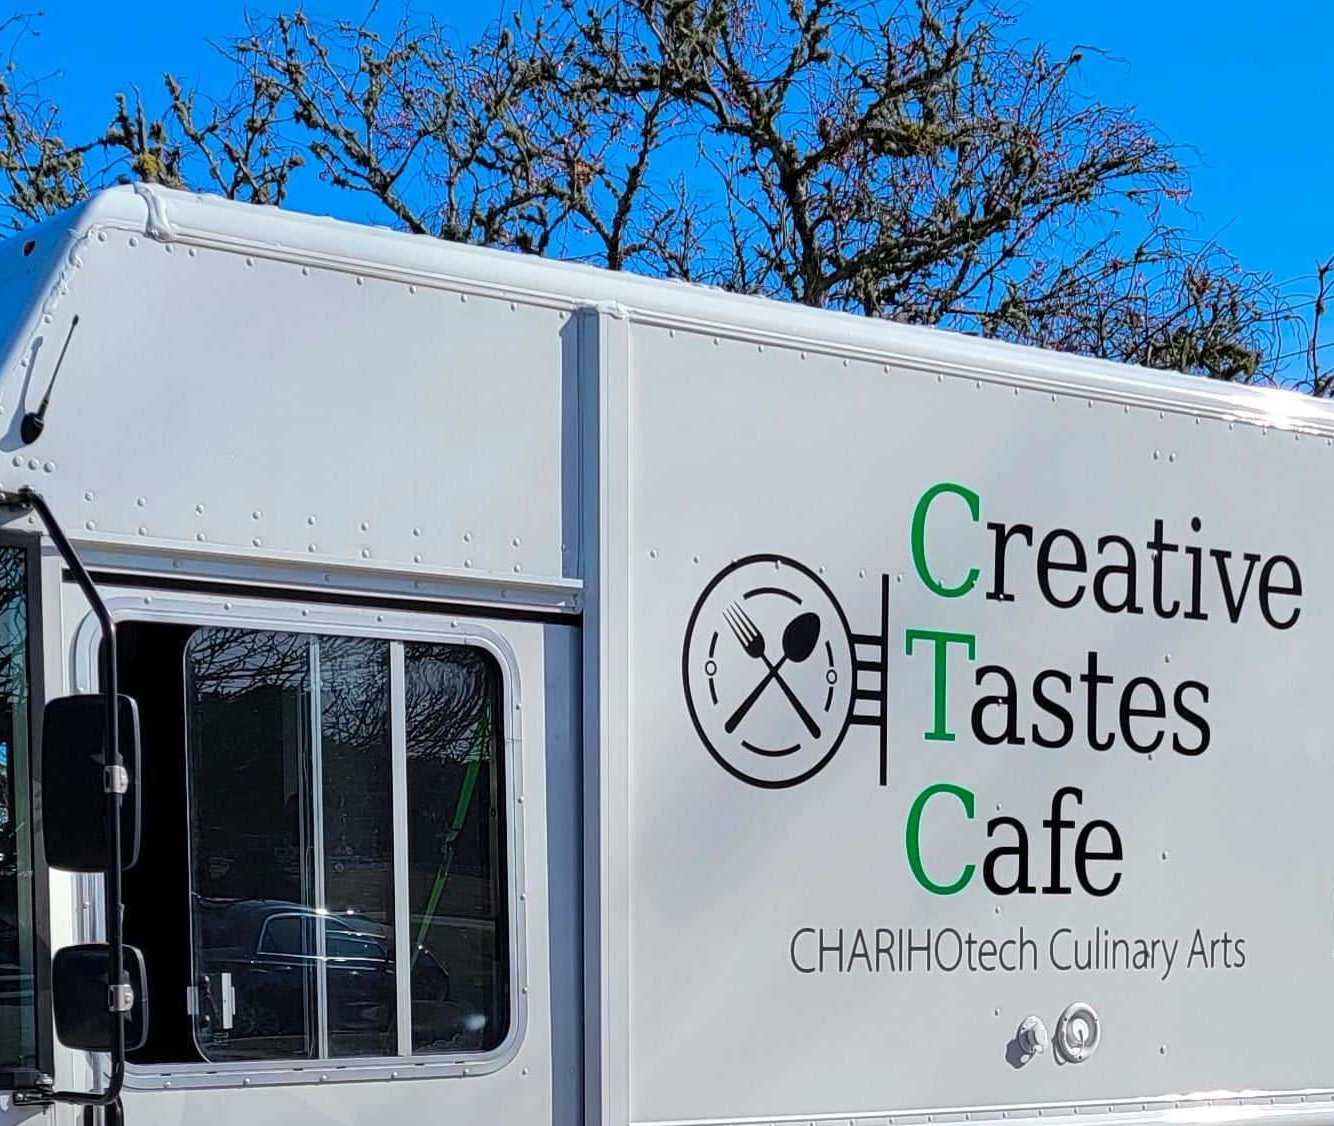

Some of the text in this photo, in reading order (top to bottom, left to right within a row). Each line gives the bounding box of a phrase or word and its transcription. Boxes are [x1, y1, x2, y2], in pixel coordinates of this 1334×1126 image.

[910, 482, 1302, 630] Creative
[905, 629, 1211, 756] Tastes
[905, 783, 1124, 897] Cafe
[789, 925, 1247, 981] CHARIHOtech Culinary Arts
